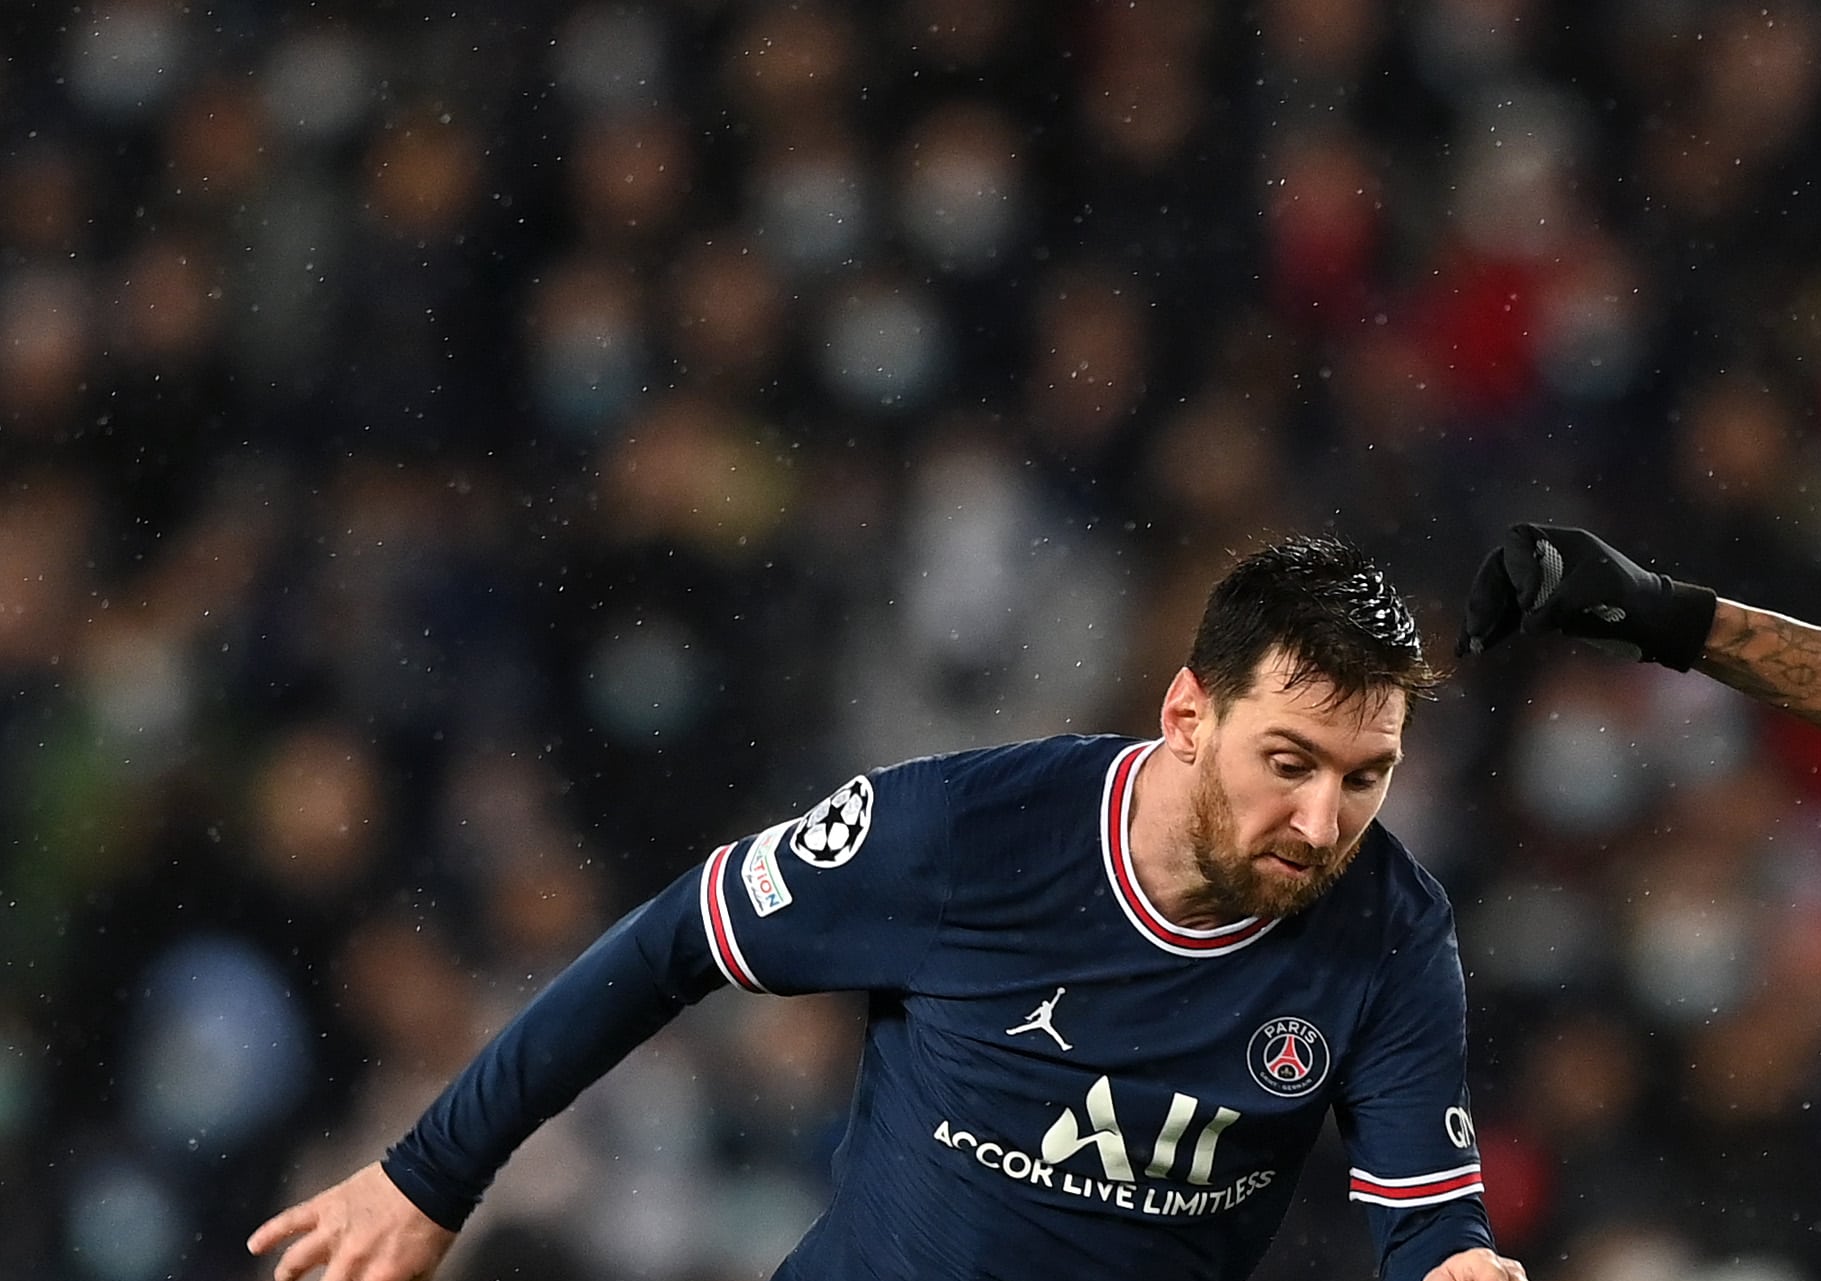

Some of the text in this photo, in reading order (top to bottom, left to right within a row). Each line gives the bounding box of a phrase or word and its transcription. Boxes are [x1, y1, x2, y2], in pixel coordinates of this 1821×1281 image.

[1263, 1021, 1318, 1044] PARIS
[933, 1120, 1276, 1216] ACCOR LIVE LIMITLESS
